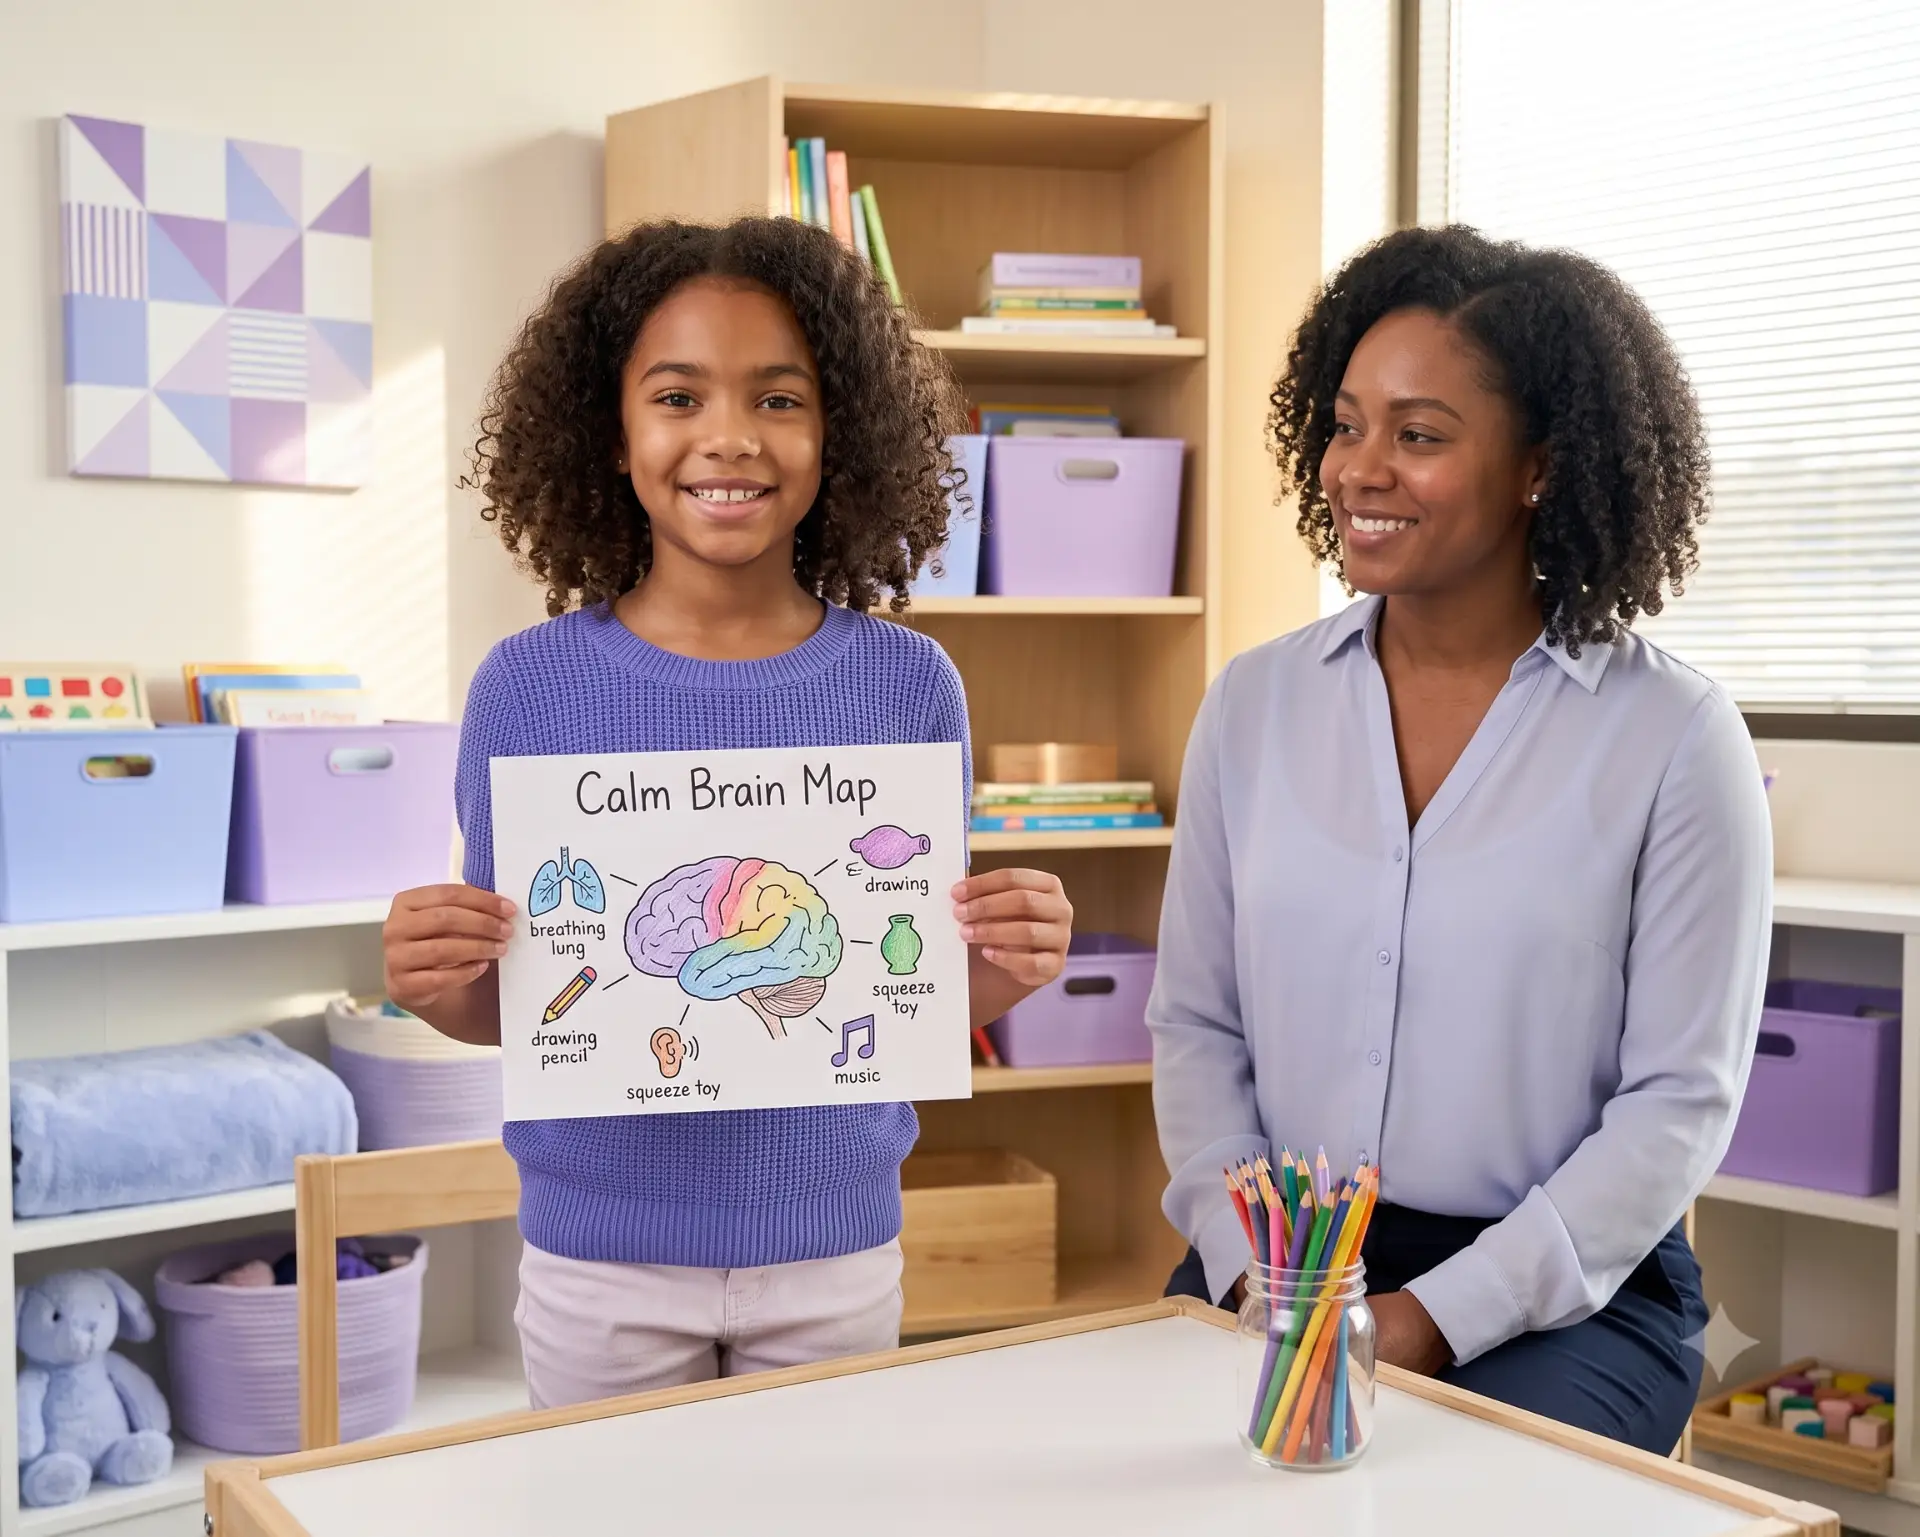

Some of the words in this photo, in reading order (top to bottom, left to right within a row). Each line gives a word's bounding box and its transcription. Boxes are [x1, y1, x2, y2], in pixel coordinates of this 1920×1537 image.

[576, 770, 671, 816] Calm
[690, 766, 786, 811] Brain
[803, 762, 877, 817] Map
[864, 875, 929, 897] drawing
[530, 919, 606, 941] breathing
[551, 940, 585, 961] lung
[872, 982, 936, 1001] squeeze
[891, 1000, 919, 1020] toy
[531, 1029, 597, 1052] drawing
[541, 1048, 588, 1071] pencil
[834, 1067, 881, 1085] music
[626, 1085, 691, 1104] squeeze
[694, 1079, 721, 1101] toy
